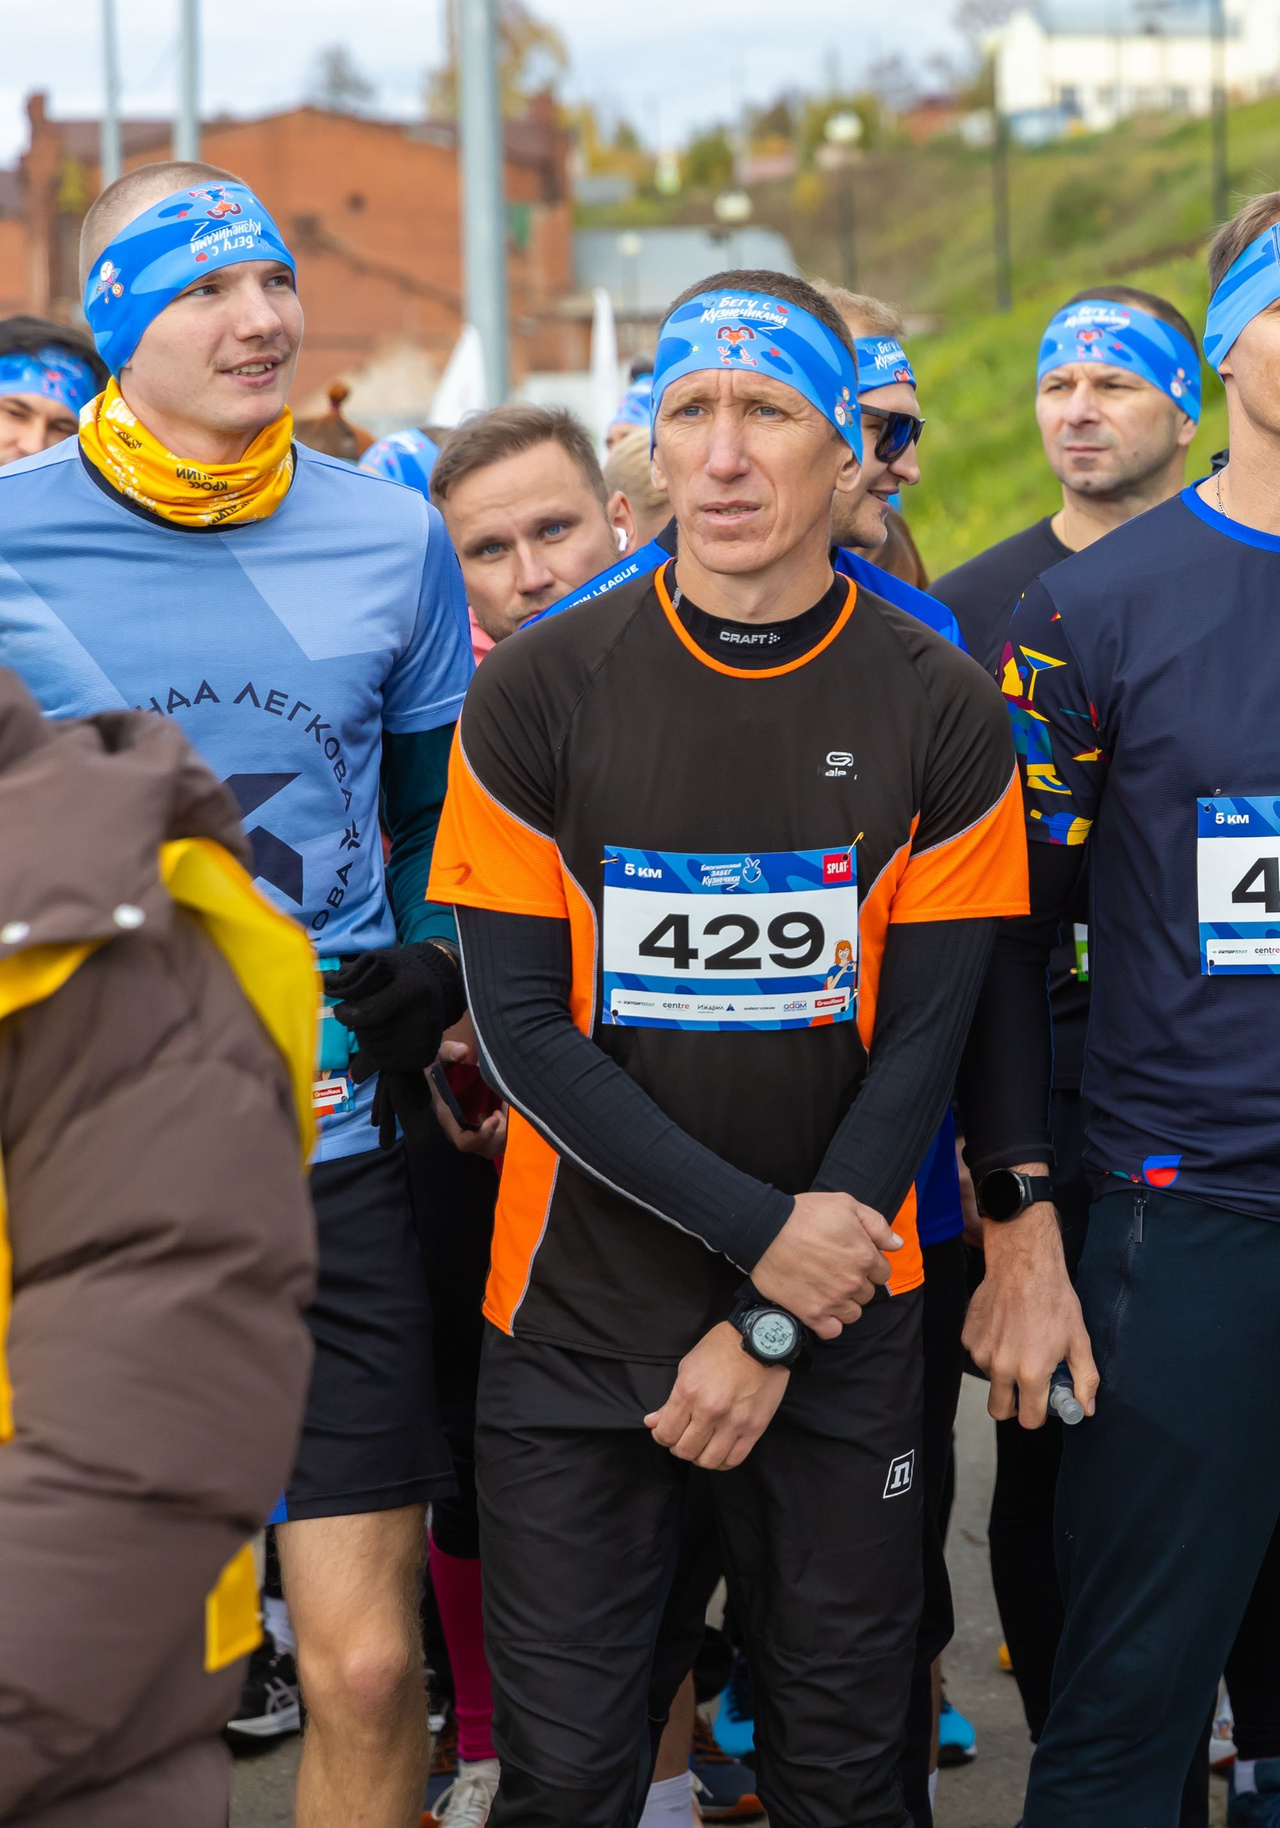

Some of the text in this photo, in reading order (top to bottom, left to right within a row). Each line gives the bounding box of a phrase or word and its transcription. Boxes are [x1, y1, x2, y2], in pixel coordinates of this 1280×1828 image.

[592, 563, 639, 597] LEAGUE
[719, 631, 768, 644] CRAFT
[1215, 812, 1225, 824] 5
[624, 863, 635, 876] 5
[827, 861, 848, 875] SPLAT
[638, 911, 825, 970] 429
[1254, 947, 1280, 955] centre
[662, 1001, 690, 1010] centre
